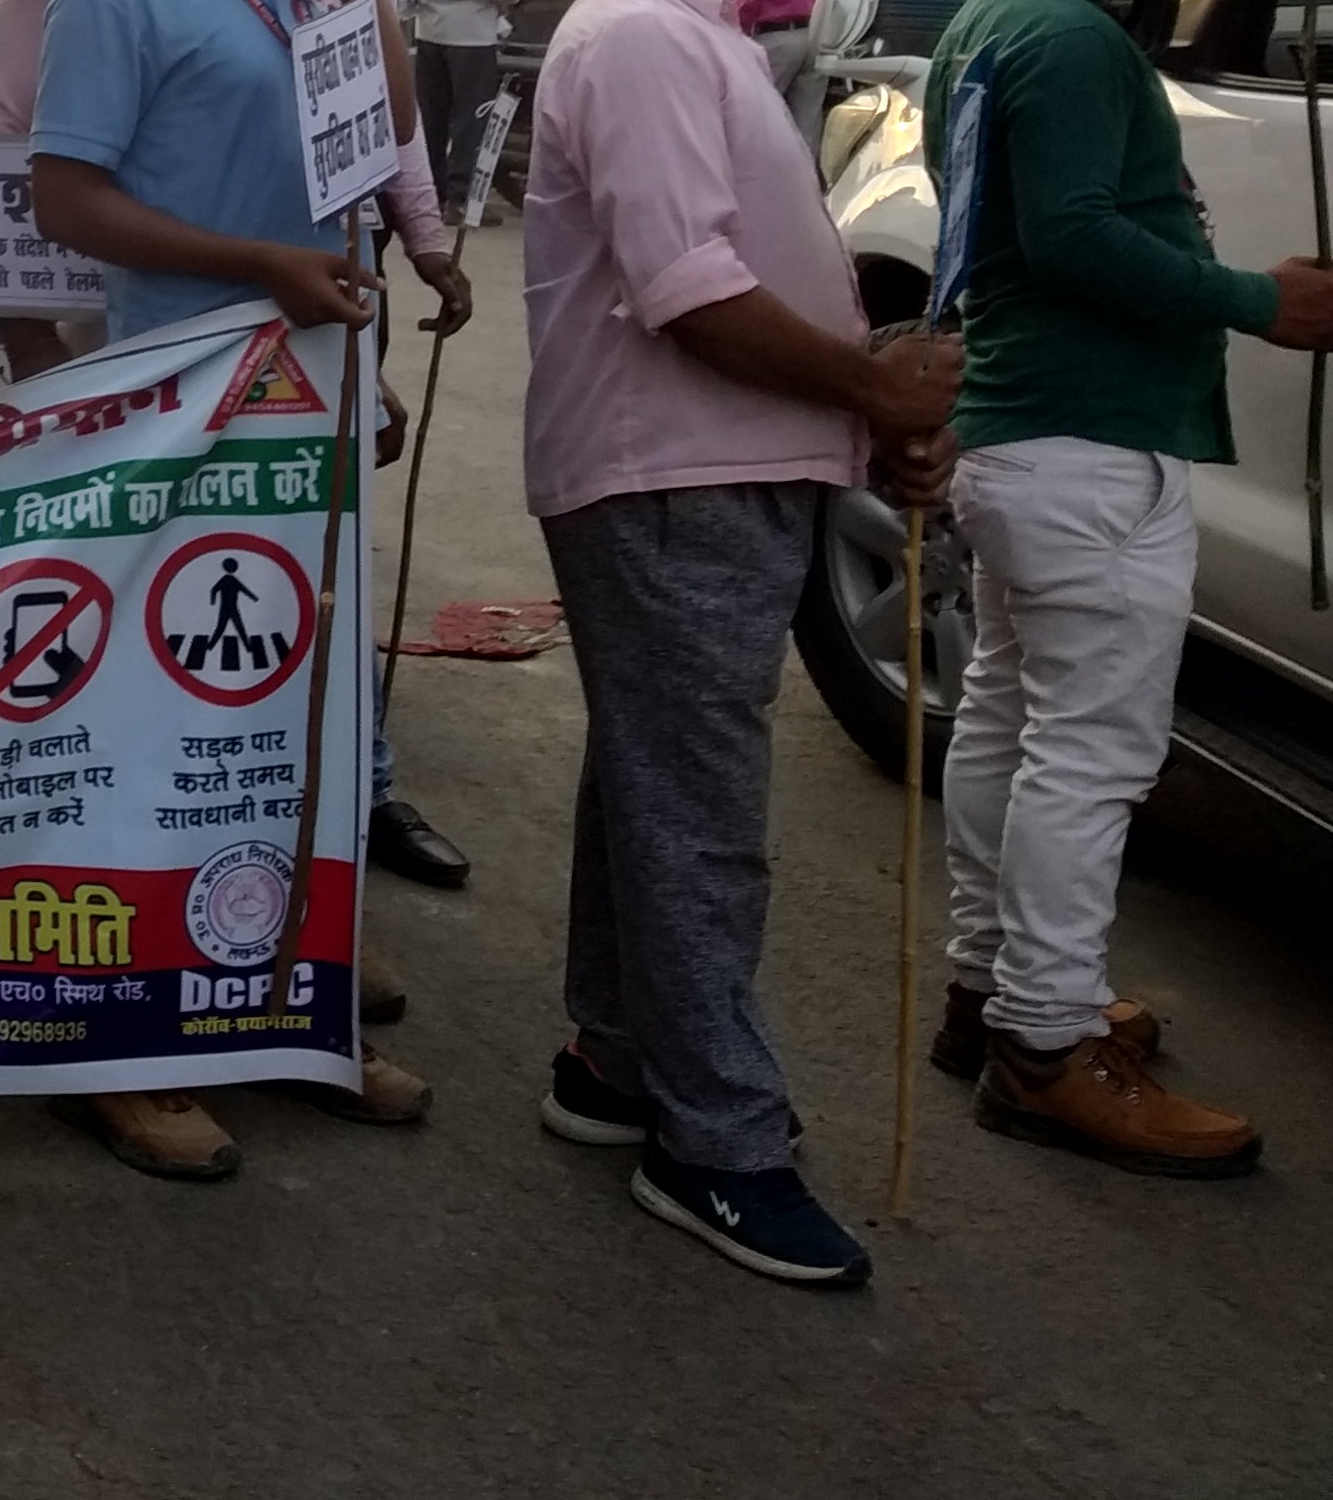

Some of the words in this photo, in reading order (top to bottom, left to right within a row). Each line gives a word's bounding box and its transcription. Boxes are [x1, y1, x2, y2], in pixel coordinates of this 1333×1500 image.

[13, 470, 116, 538] नियमों
[124, 480, 175, 525] का
[270, 445, 324, 505] करें
[28, 724, 91, 758] चलाते
[250, 729, 287, 753] पार
[84, 766, 115, 789] पर
[172, 761, 230, 794] करते
[236, 763, 296, 789] समय
[22, 810, 40, 829] न
[46, 798, 86, 827] करें
[155, 794, 257, 829] सावधानी
